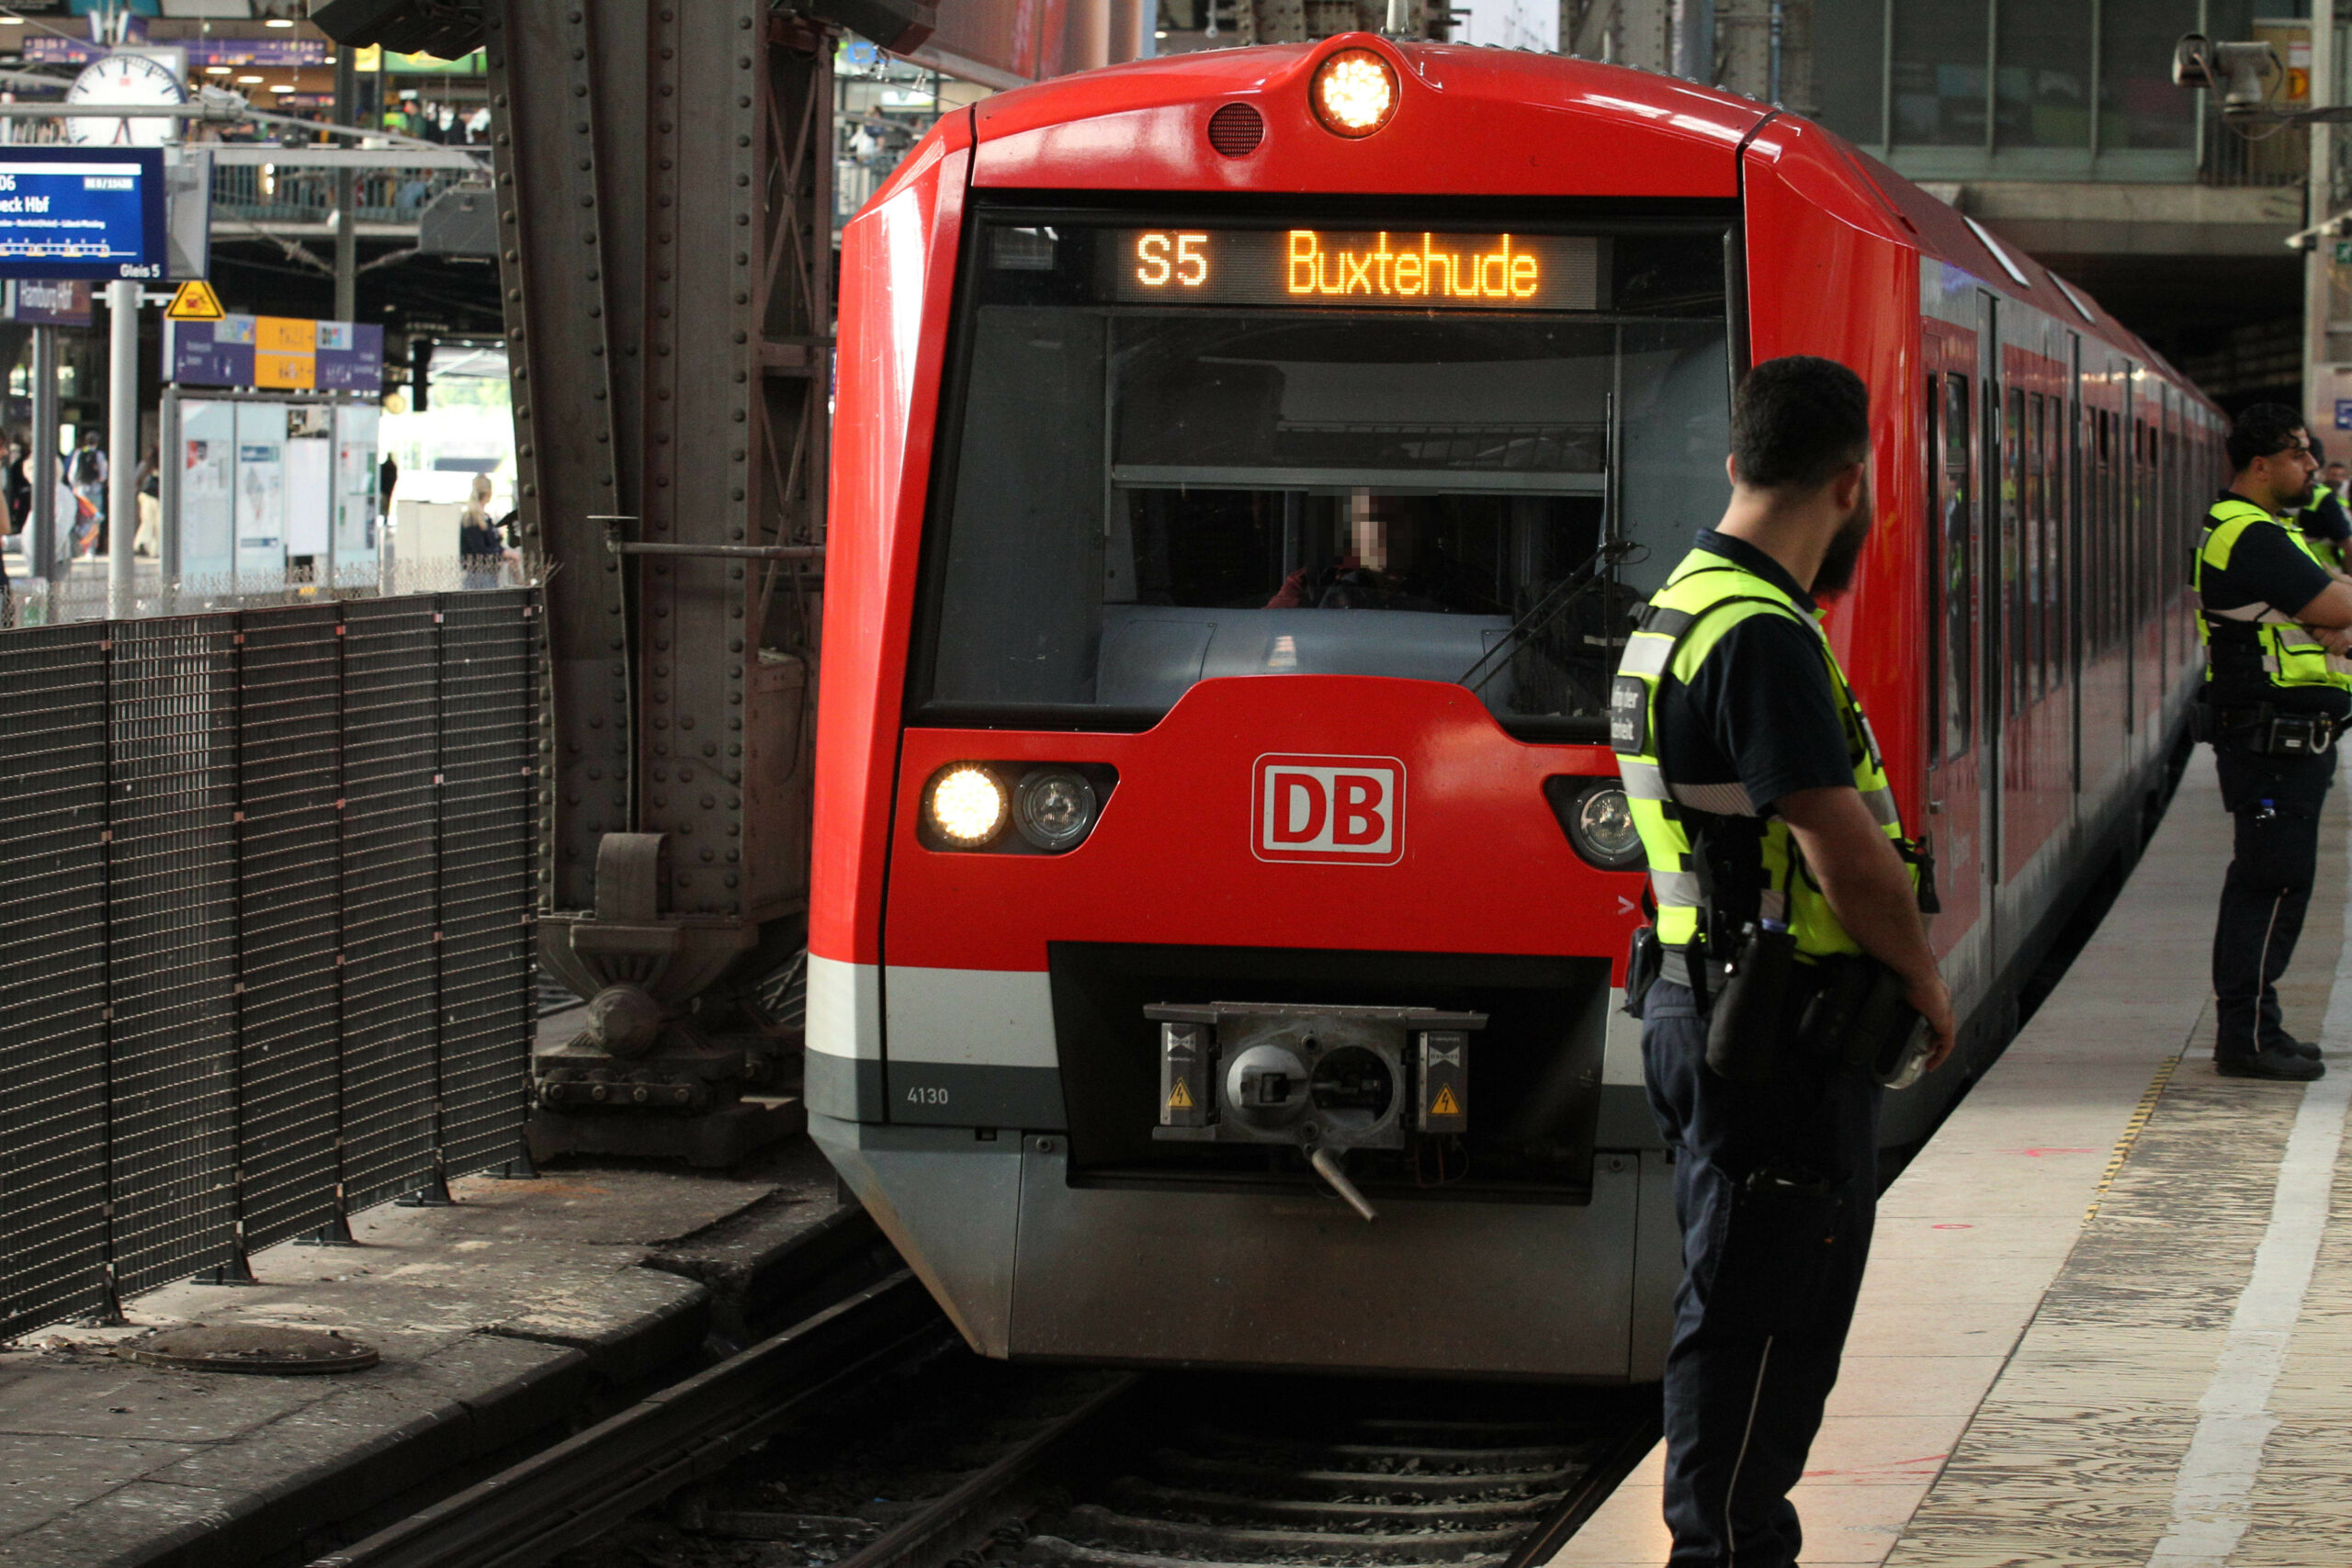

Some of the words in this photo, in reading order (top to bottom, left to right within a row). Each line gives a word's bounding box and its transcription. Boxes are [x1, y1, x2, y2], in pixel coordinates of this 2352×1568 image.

[25, 196, 50, 212] Hbf
[119, 264, 150, 277] Gleis
[152, 265, 160, 277] 5
[1137, 234, 1207, 286] S5
[1288, 231, 1538, 297] Buxtehude
[1272, 773, 1385, 845] DB
[907, 1087, 948, 1104] 4130
